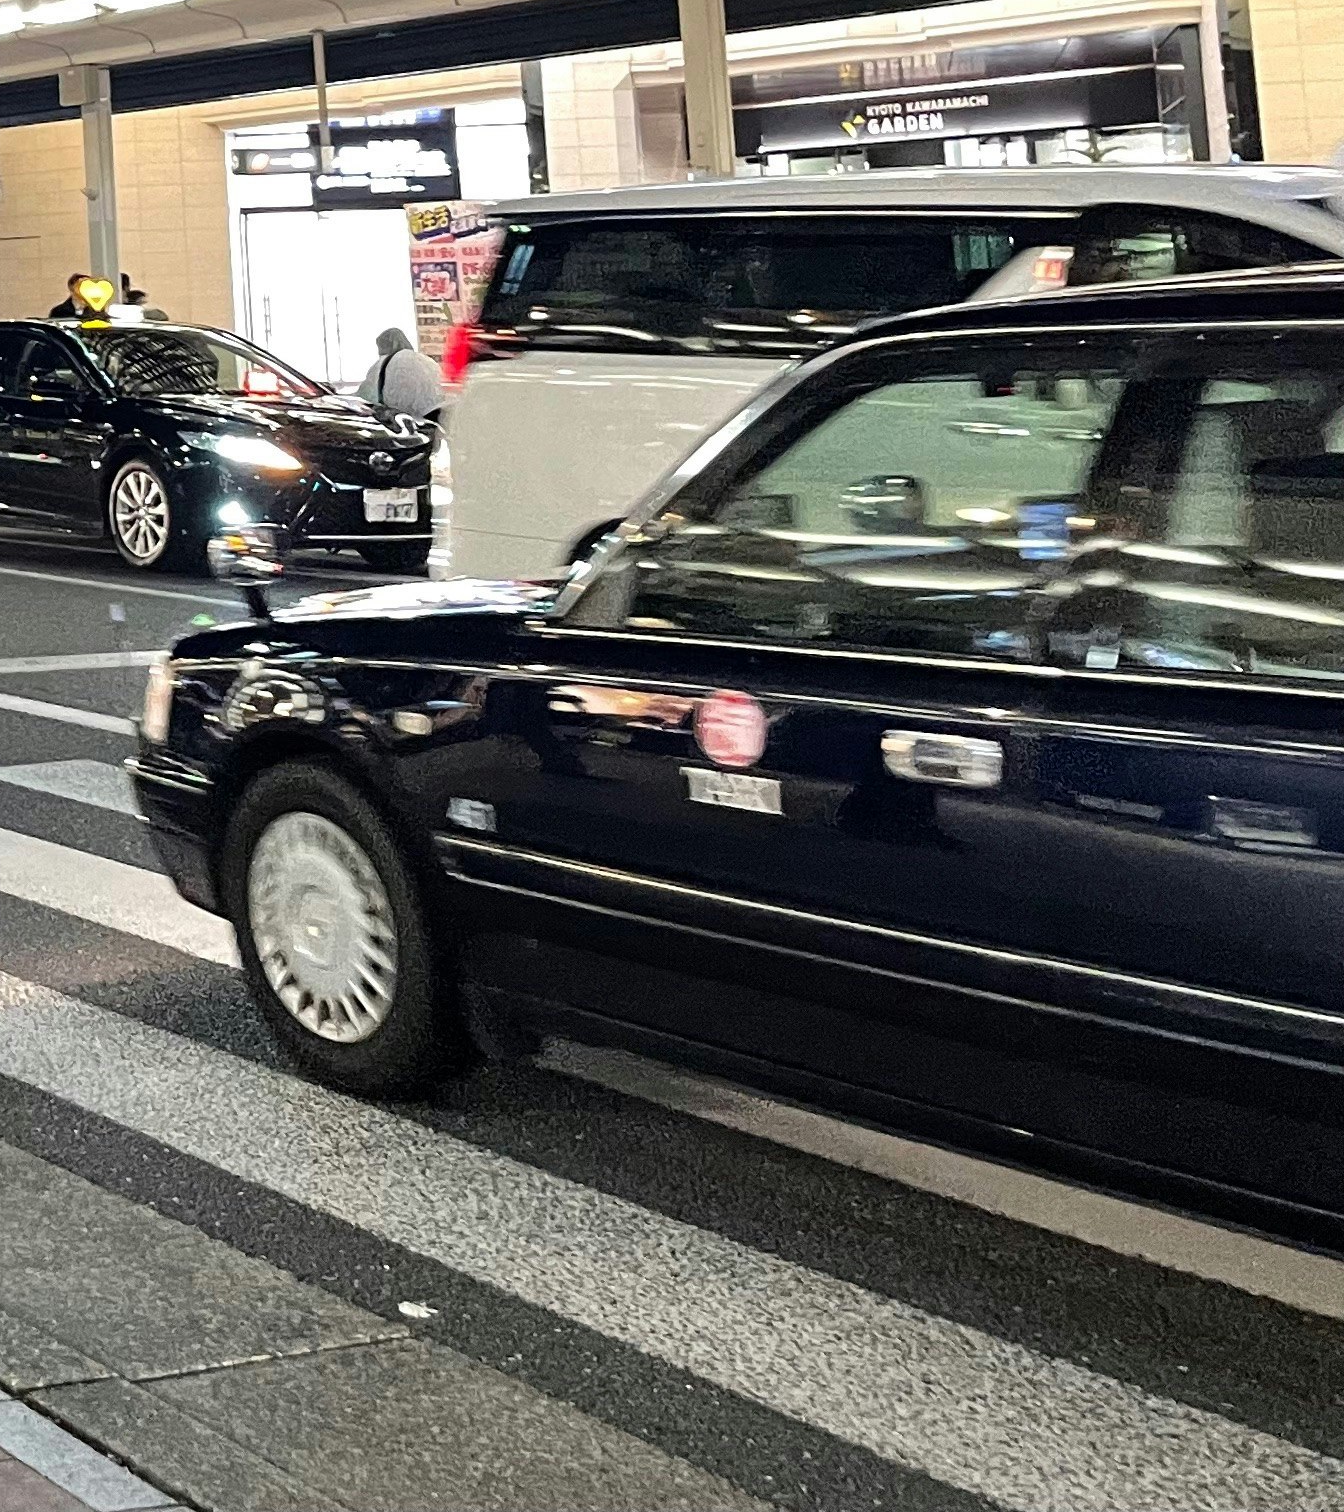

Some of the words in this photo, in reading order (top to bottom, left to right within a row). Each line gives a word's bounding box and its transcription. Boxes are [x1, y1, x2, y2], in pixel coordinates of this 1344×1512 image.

[866, 103, 902, 116] KYOTO
[906, 95, 989, 112] KAWARAMACHI
[867, 113, 944, 135] GARDEN
